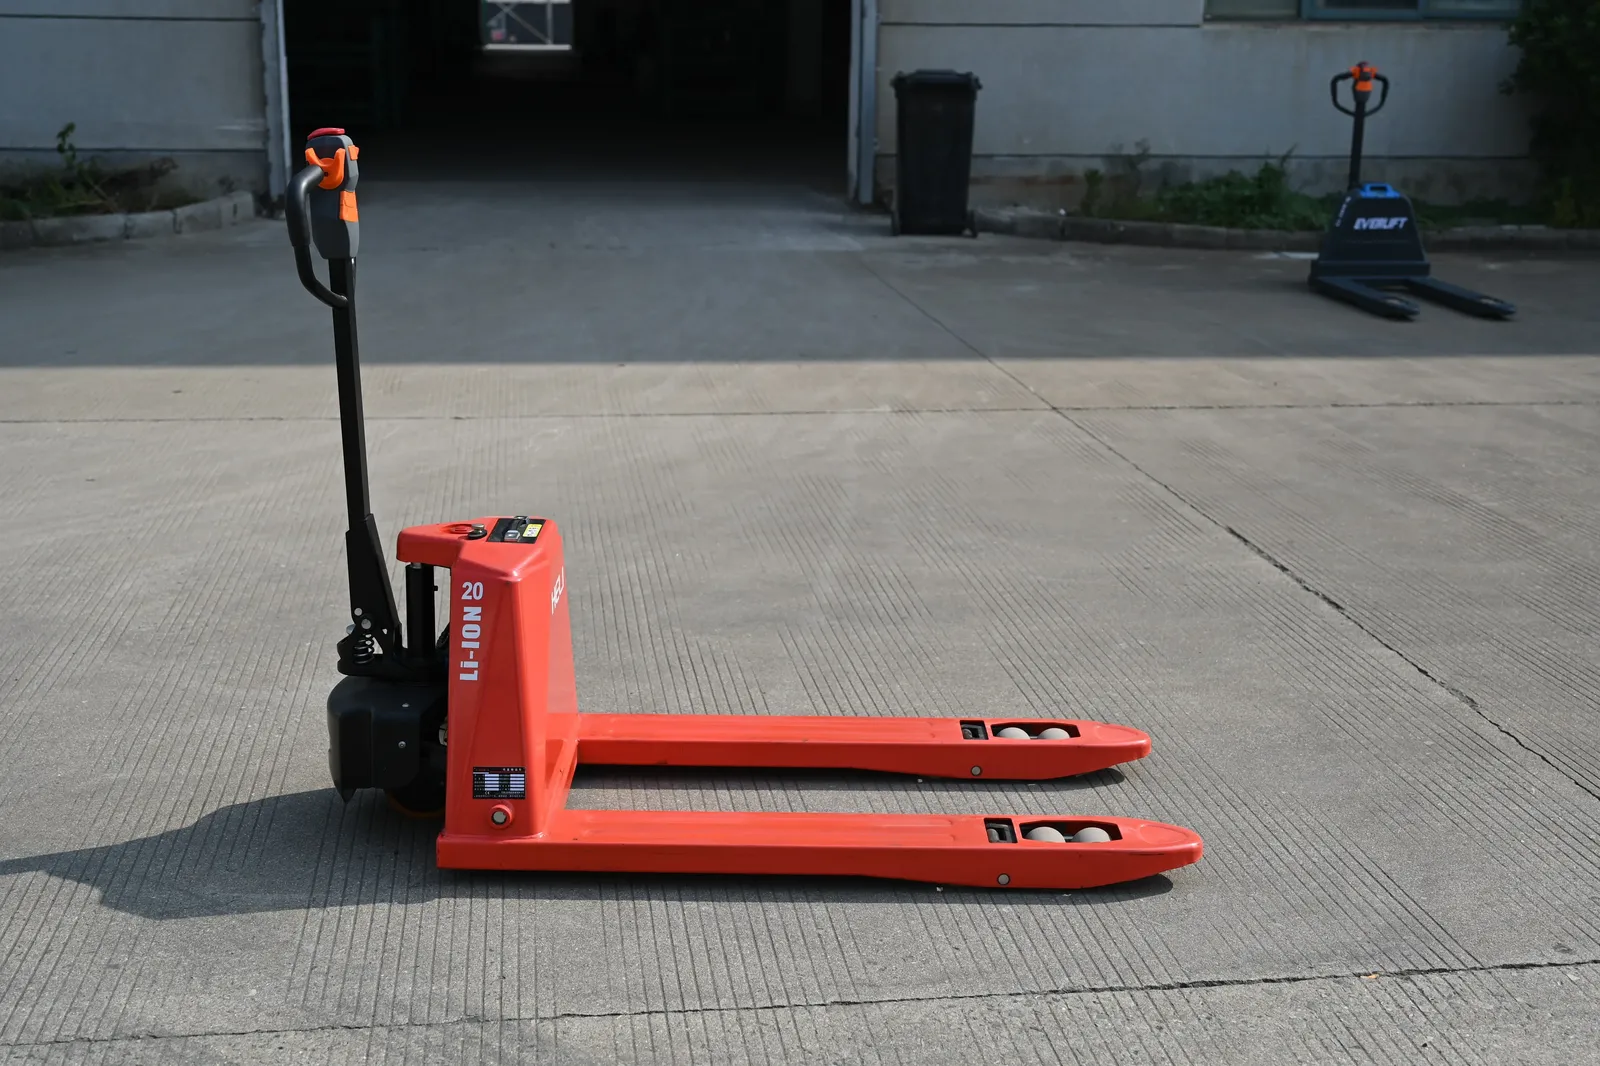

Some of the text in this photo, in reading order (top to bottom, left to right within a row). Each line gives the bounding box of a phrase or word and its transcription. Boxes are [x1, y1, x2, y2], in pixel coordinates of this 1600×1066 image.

[1353, 216, 1408, 231] EVERLIFT
[461, 581, 484, 600] 20
[460, 606, 482, 681] Li-ION
